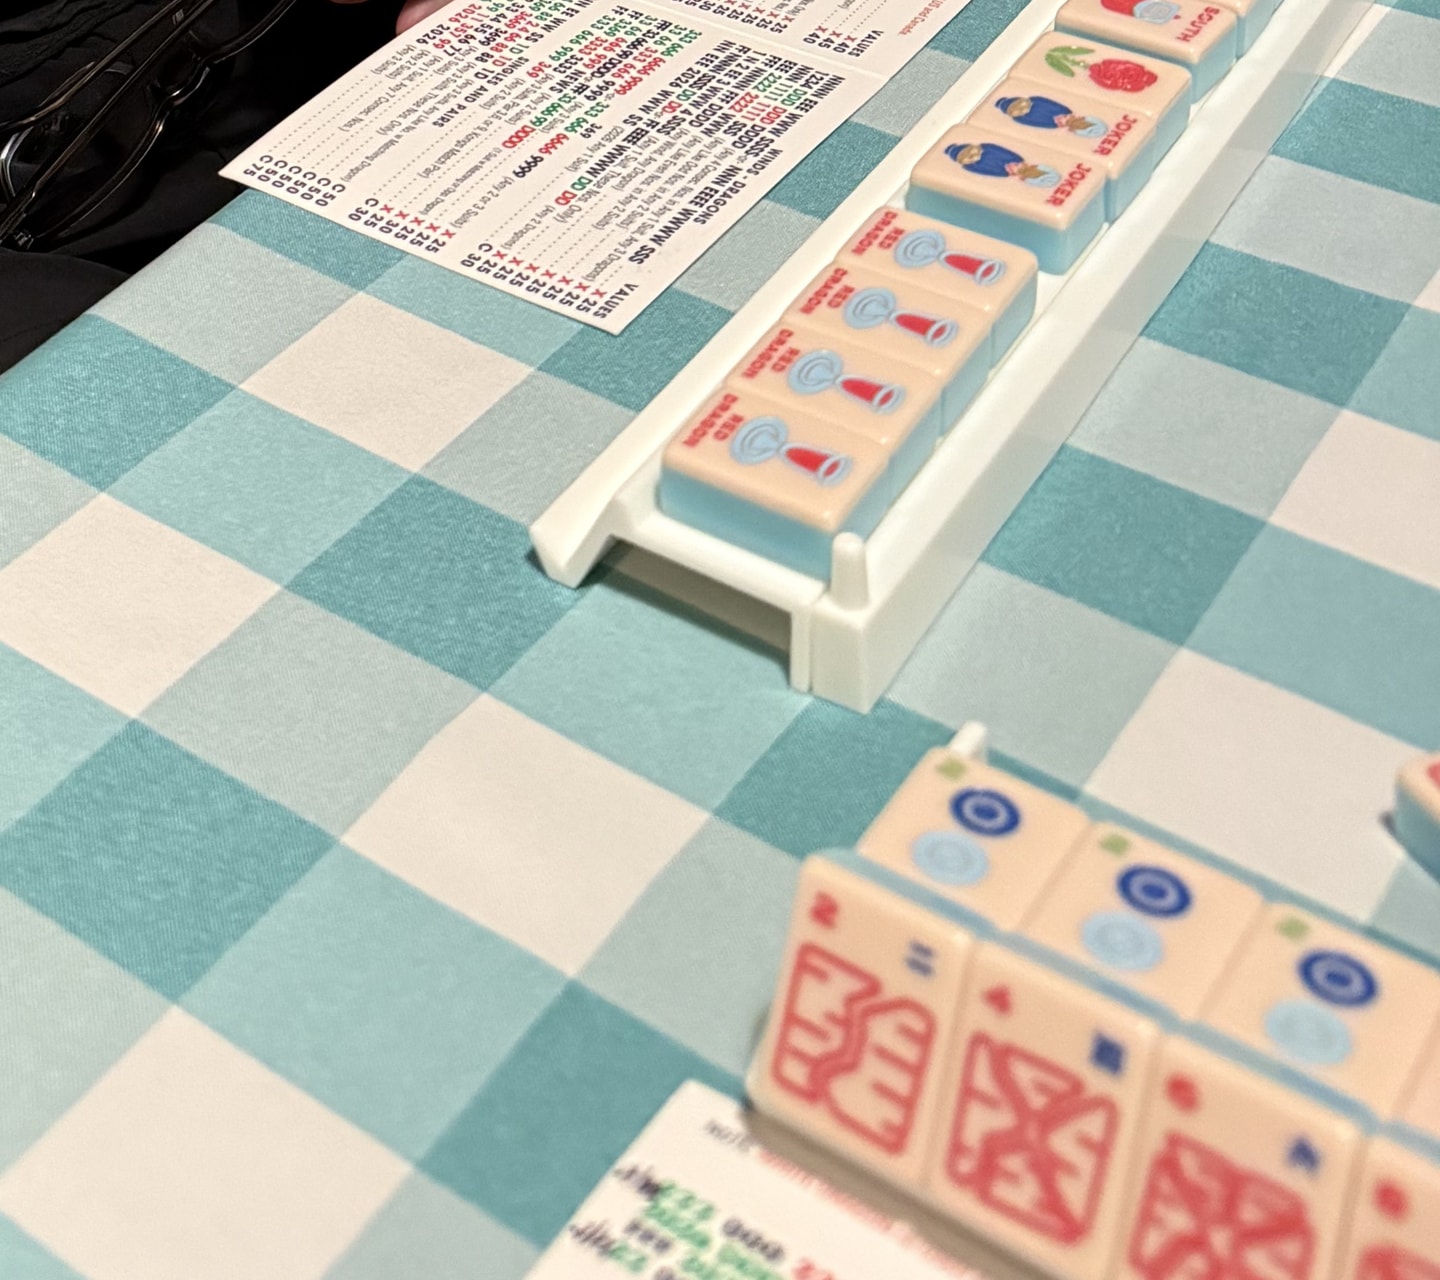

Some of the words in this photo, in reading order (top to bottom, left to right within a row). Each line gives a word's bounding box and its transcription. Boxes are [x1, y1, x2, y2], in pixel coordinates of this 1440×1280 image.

[447, 3, 483, 23] 2026
[1176, 7, 1220, 43] SOUTH
[415, 23, 451, 45] 2026
[847, 29, 884, 57] VALUES
[395, 44, 418, 56] (Any
[369, 59, 397, 74] Suits)
[486, 56, 530, 85] SINGLES
[463, 85, 490, 102] AND
[810, 74, 845, 99] NNNN
[431, 103, 468, 127] PAIRS
[794, 98, 818, 113] EEE
[578, 123, 603, 138] 369
[767, 112, 803, 137] WWW
[1093, 114, 1138, 156] JOKER
[743, 135, 775, 157] SSSS
[241, 163, 265, 176] 75
[256, 153, 276, 164] C
[746, 148, 783, 175] WINDS
[710, 164, 743, 187] NNN
[1046, 162, 1092, 206] JOKER
[688, 186, 719, 208] EEEE
[692, 181, 746, 224] DRAGONS
[648, 207, 697, 246] WWWW
[851, 210, 898, 256] DRAGON
[878, 227, 905, 250] RED
[627, 244, 656, 264] SSS
[592, 282, 639, 319] VALUES
[798, 267, 848, 314] DRAGON
[827, 285, 855, 309] RED
[575, 297, 598, 313] 25
[741, 329, 794, 379] DRAGON
[771, 347, 801, 373] RED
[682, 393, 739, 448] DRAGON
[713, 414, 744, 441] RED
